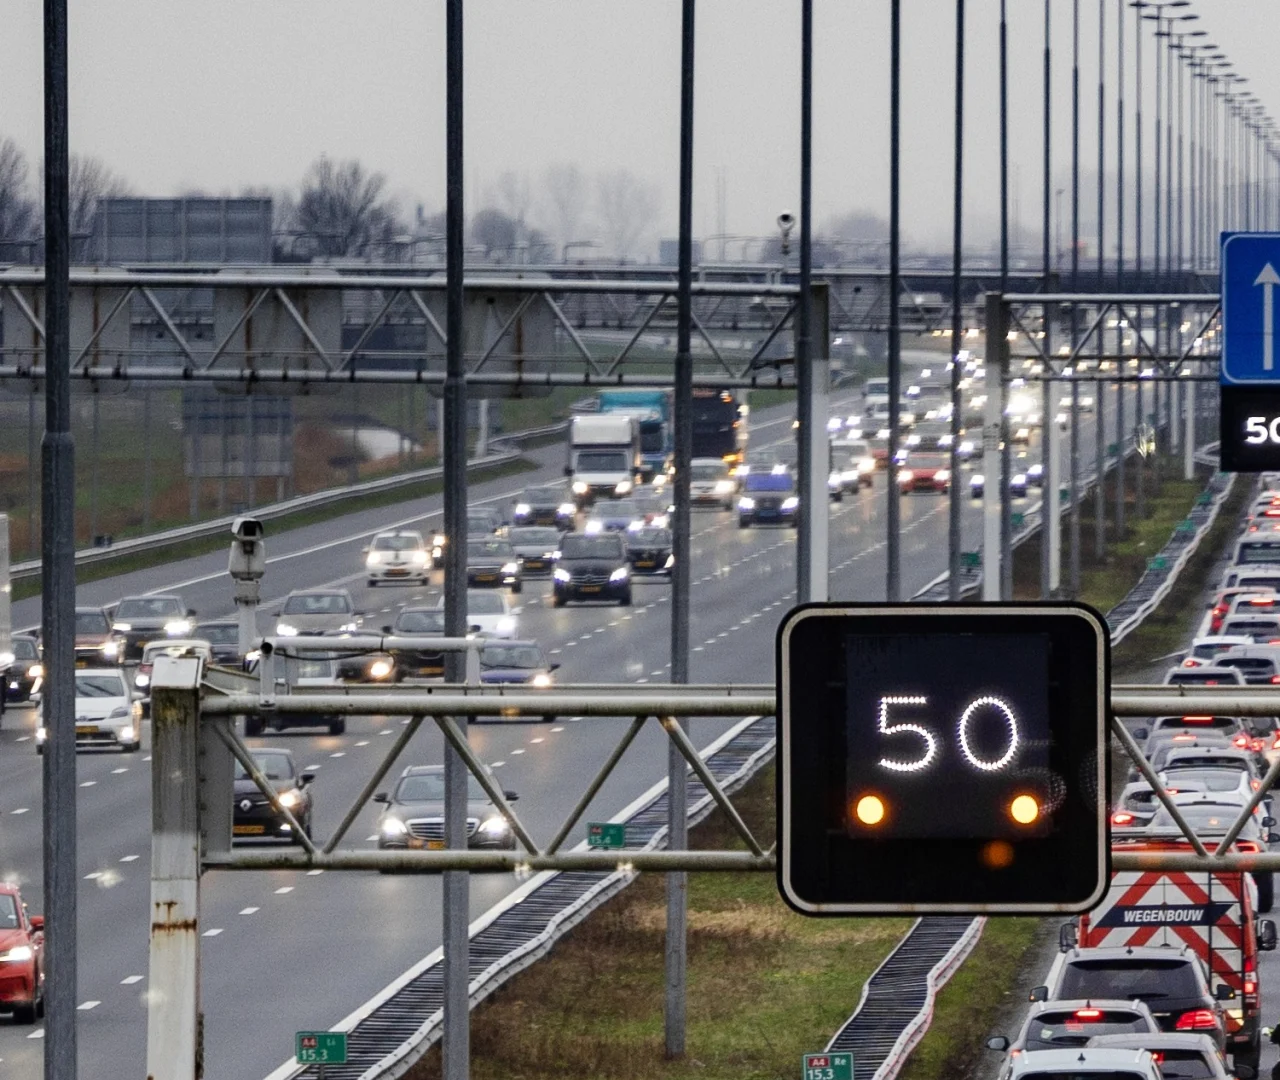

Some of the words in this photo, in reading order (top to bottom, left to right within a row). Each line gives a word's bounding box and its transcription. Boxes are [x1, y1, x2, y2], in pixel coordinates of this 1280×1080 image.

[879, 697, 1019, 771] 50
[1124, 909, 1204, 923] WEGENBOUW
[812, 1058, 825, 1067] A4
[834, 1058, 847, 1066] Re
